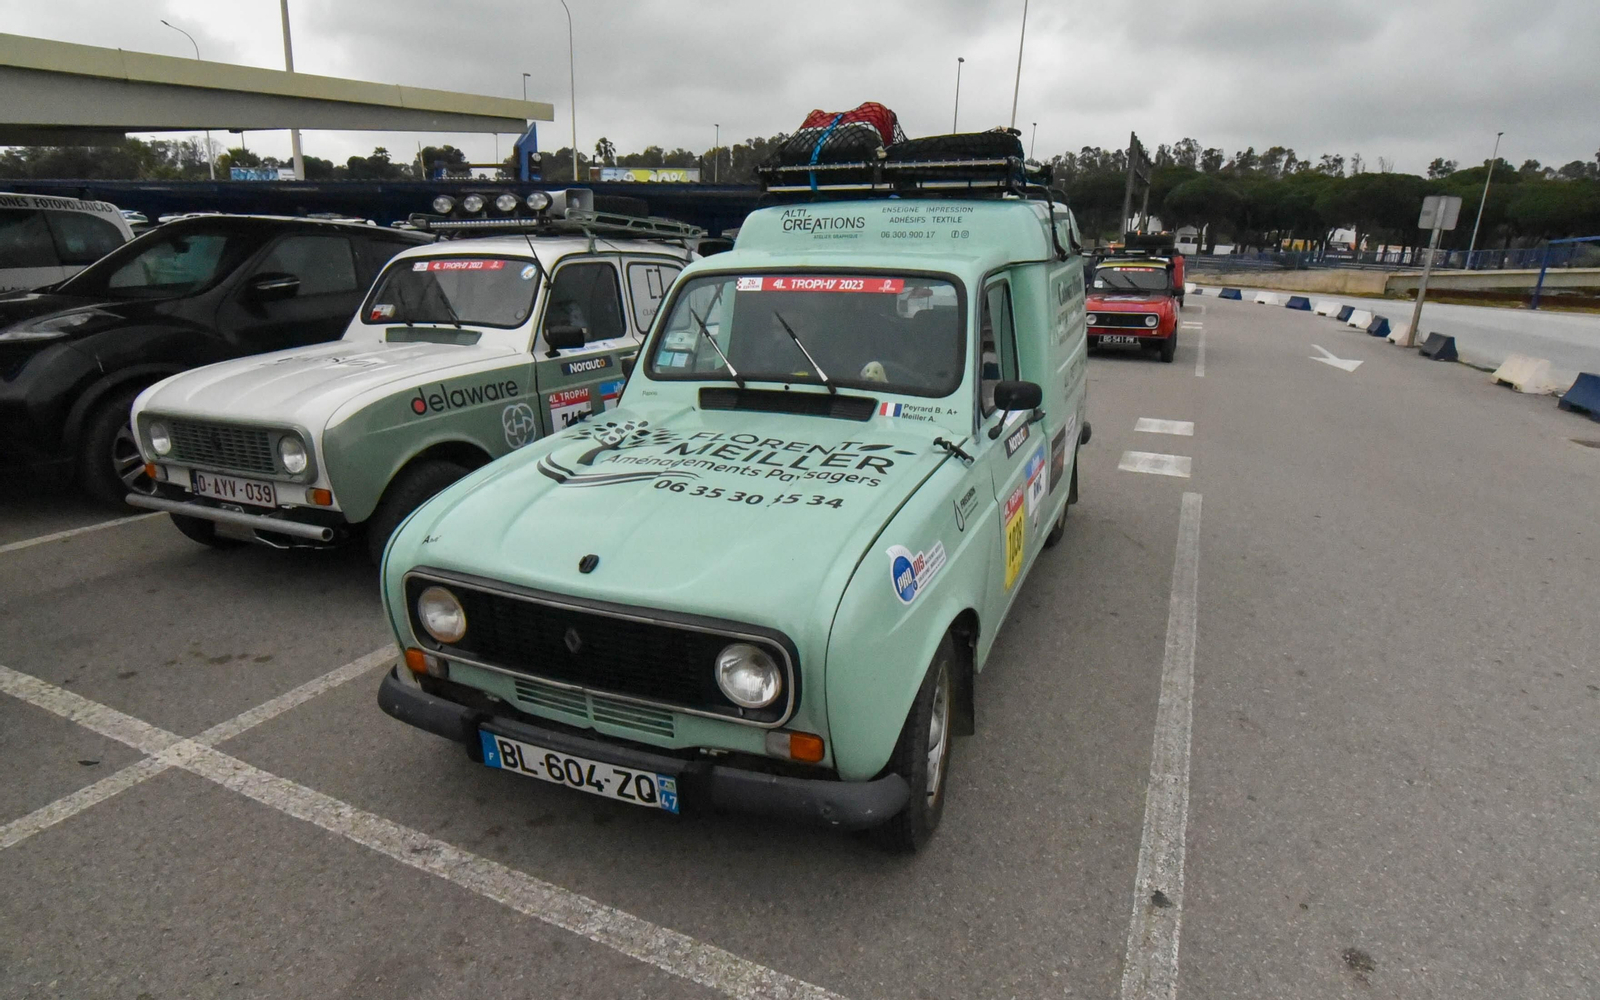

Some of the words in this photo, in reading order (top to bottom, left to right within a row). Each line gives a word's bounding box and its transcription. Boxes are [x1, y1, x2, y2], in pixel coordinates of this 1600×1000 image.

[34, 197, 113, 213] FOTOVOLTAICAS
[781, 208, 807, 221] ALTI
[889, 215, 926, 224] ADHÉSIFS
[932, 216, 962, 224] TEXTILE
[783, 213, 866, 234] CRÉATIONS
[443, 261, 469, 269] TROPHY
[772, 279, 786, 289] 4L
[791, 279, 837, 289] TROPHY
[838, 279, 864, 290] 2023
[569, 358, 606, 374] Norauto
[410, 380, 519, 415] delaware
[549, 394, 559, 403] 4L
[560, 388, 589, 401] TROPHY
[903, 403, 934, 412] Peyrard
[902, 412, 927, 421] Meiller
[688, 431, 864, 455] FLORENT
[600, 453, 763, 477] Aménagements
[664, 442, 895, 475] MEILLER
[654, 479, 689, 493] 06
[689, 485, 726, 498] 35
[726, 491, 764, 505] 30
[806, 494, 844, 509] 34
[488, 752, 495, 761] F
[498, 739, 658, 804] BL-604-ZQ
[660, 793, 678, 811] 47
